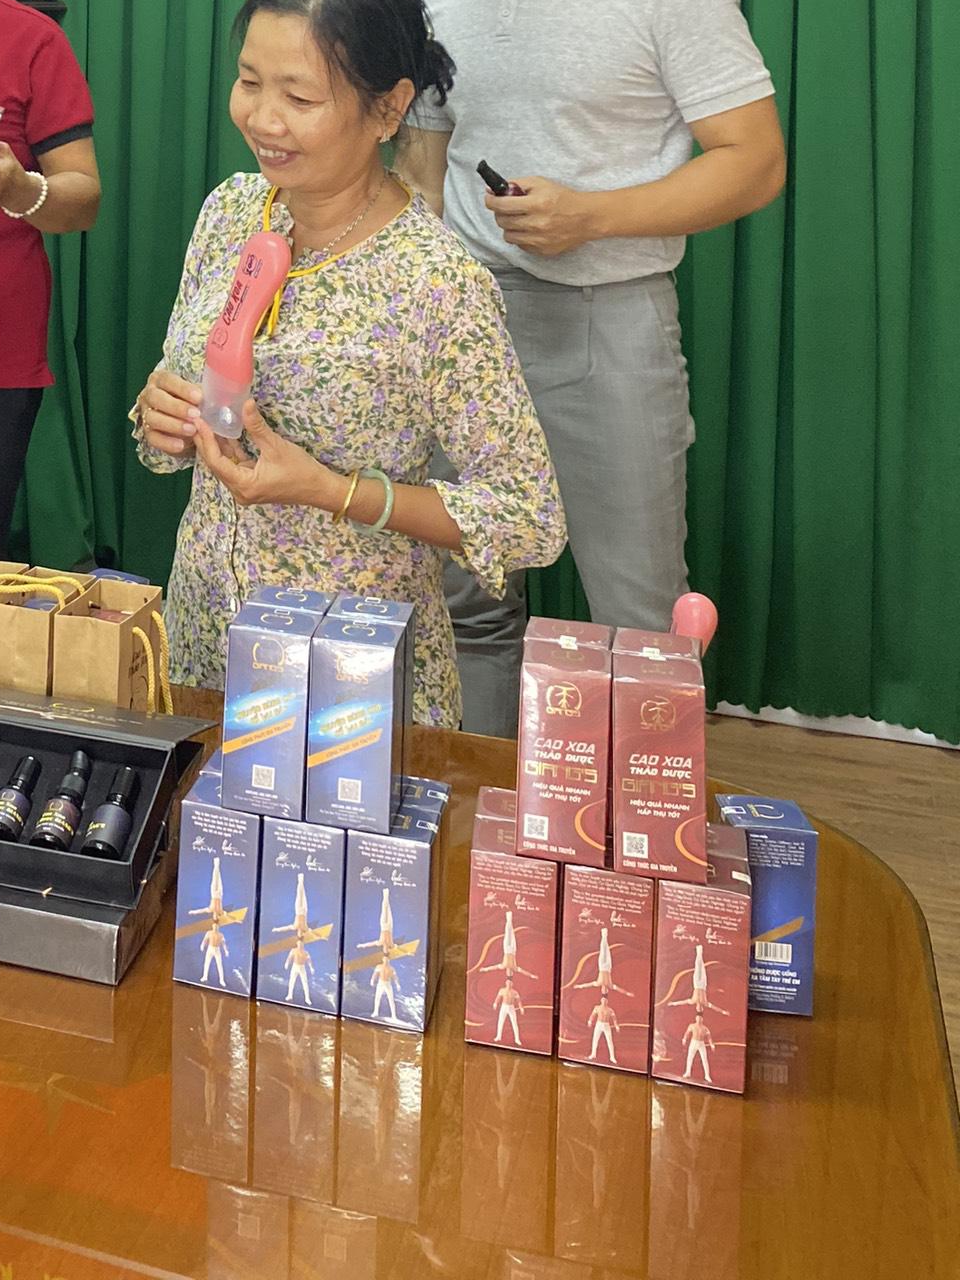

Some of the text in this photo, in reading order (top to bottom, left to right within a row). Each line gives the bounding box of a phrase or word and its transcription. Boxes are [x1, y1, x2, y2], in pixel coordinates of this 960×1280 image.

[534, 737, 596, 755] CAO XOA
[533, 749, 561, 761] THẢO
[629, 754, 693, 769] CAO XOA
[629, 765, 658, 776] THẢO
